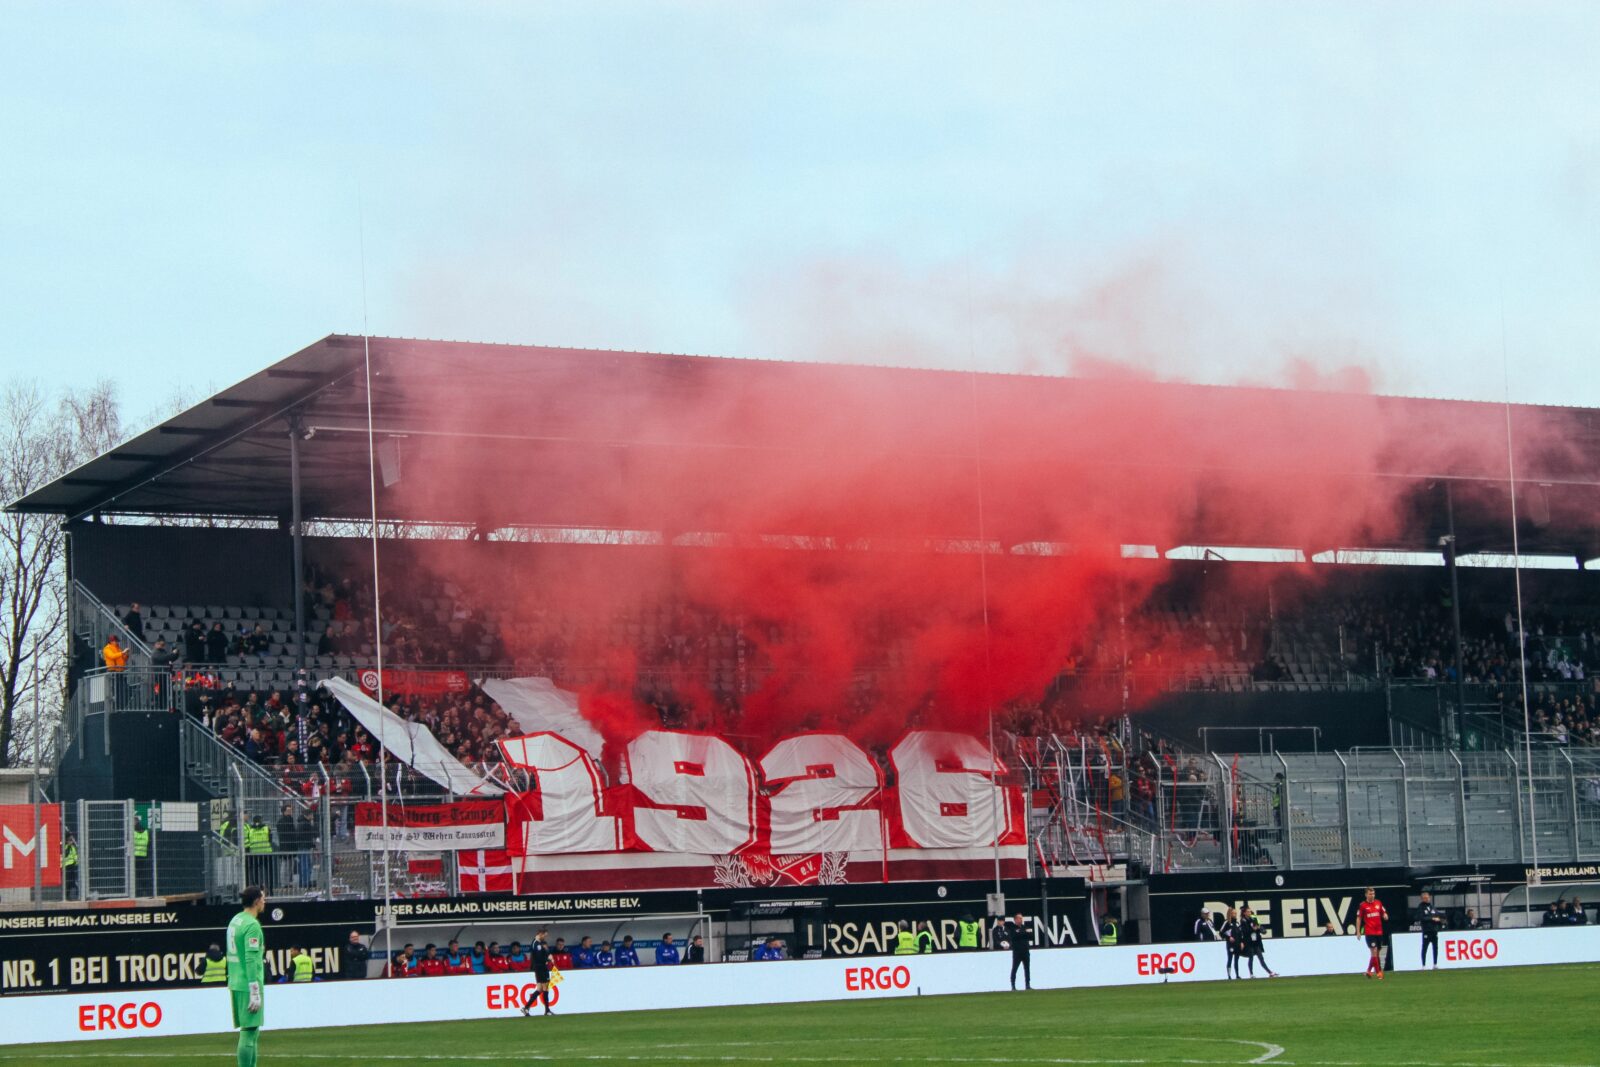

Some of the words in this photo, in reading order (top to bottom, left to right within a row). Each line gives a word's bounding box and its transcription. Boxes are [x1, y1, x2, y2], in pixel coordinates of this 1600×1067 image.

[502, 730, 1009, 855] 1926
[1553, 866, 1598, 876] SAARLAND.
[415, 902, 481, 914] SAARLAND.
[483, 901, 527, 912] UNSERE
[529, 900, 573, 910] HEIMAT.
[574, 899, 618, 909] UNSERE
[619, 898, 641, 907] ELV.
[1281, 896, 1357, 937] ELV.
[0, 917, 45, 929] NSERE
[47, 915, 99, 927] HEIMAT.
[101, 914, 150, 925] UNSERE
[153, 912, 178, 923] ELV.
[1446, 939, 1498, 960] ERGO
[2, 959, 42, 988] NR.
[48, 958, 60, 985] 1
[70, 956, 109, 985] BEI
[1137, 952, 1195, 976] ERGO
[845, 966, 911, 991] ERGO
[486, 983, 559, 1010] ERGO
[79, 1002, 163, 1031] ERGO
